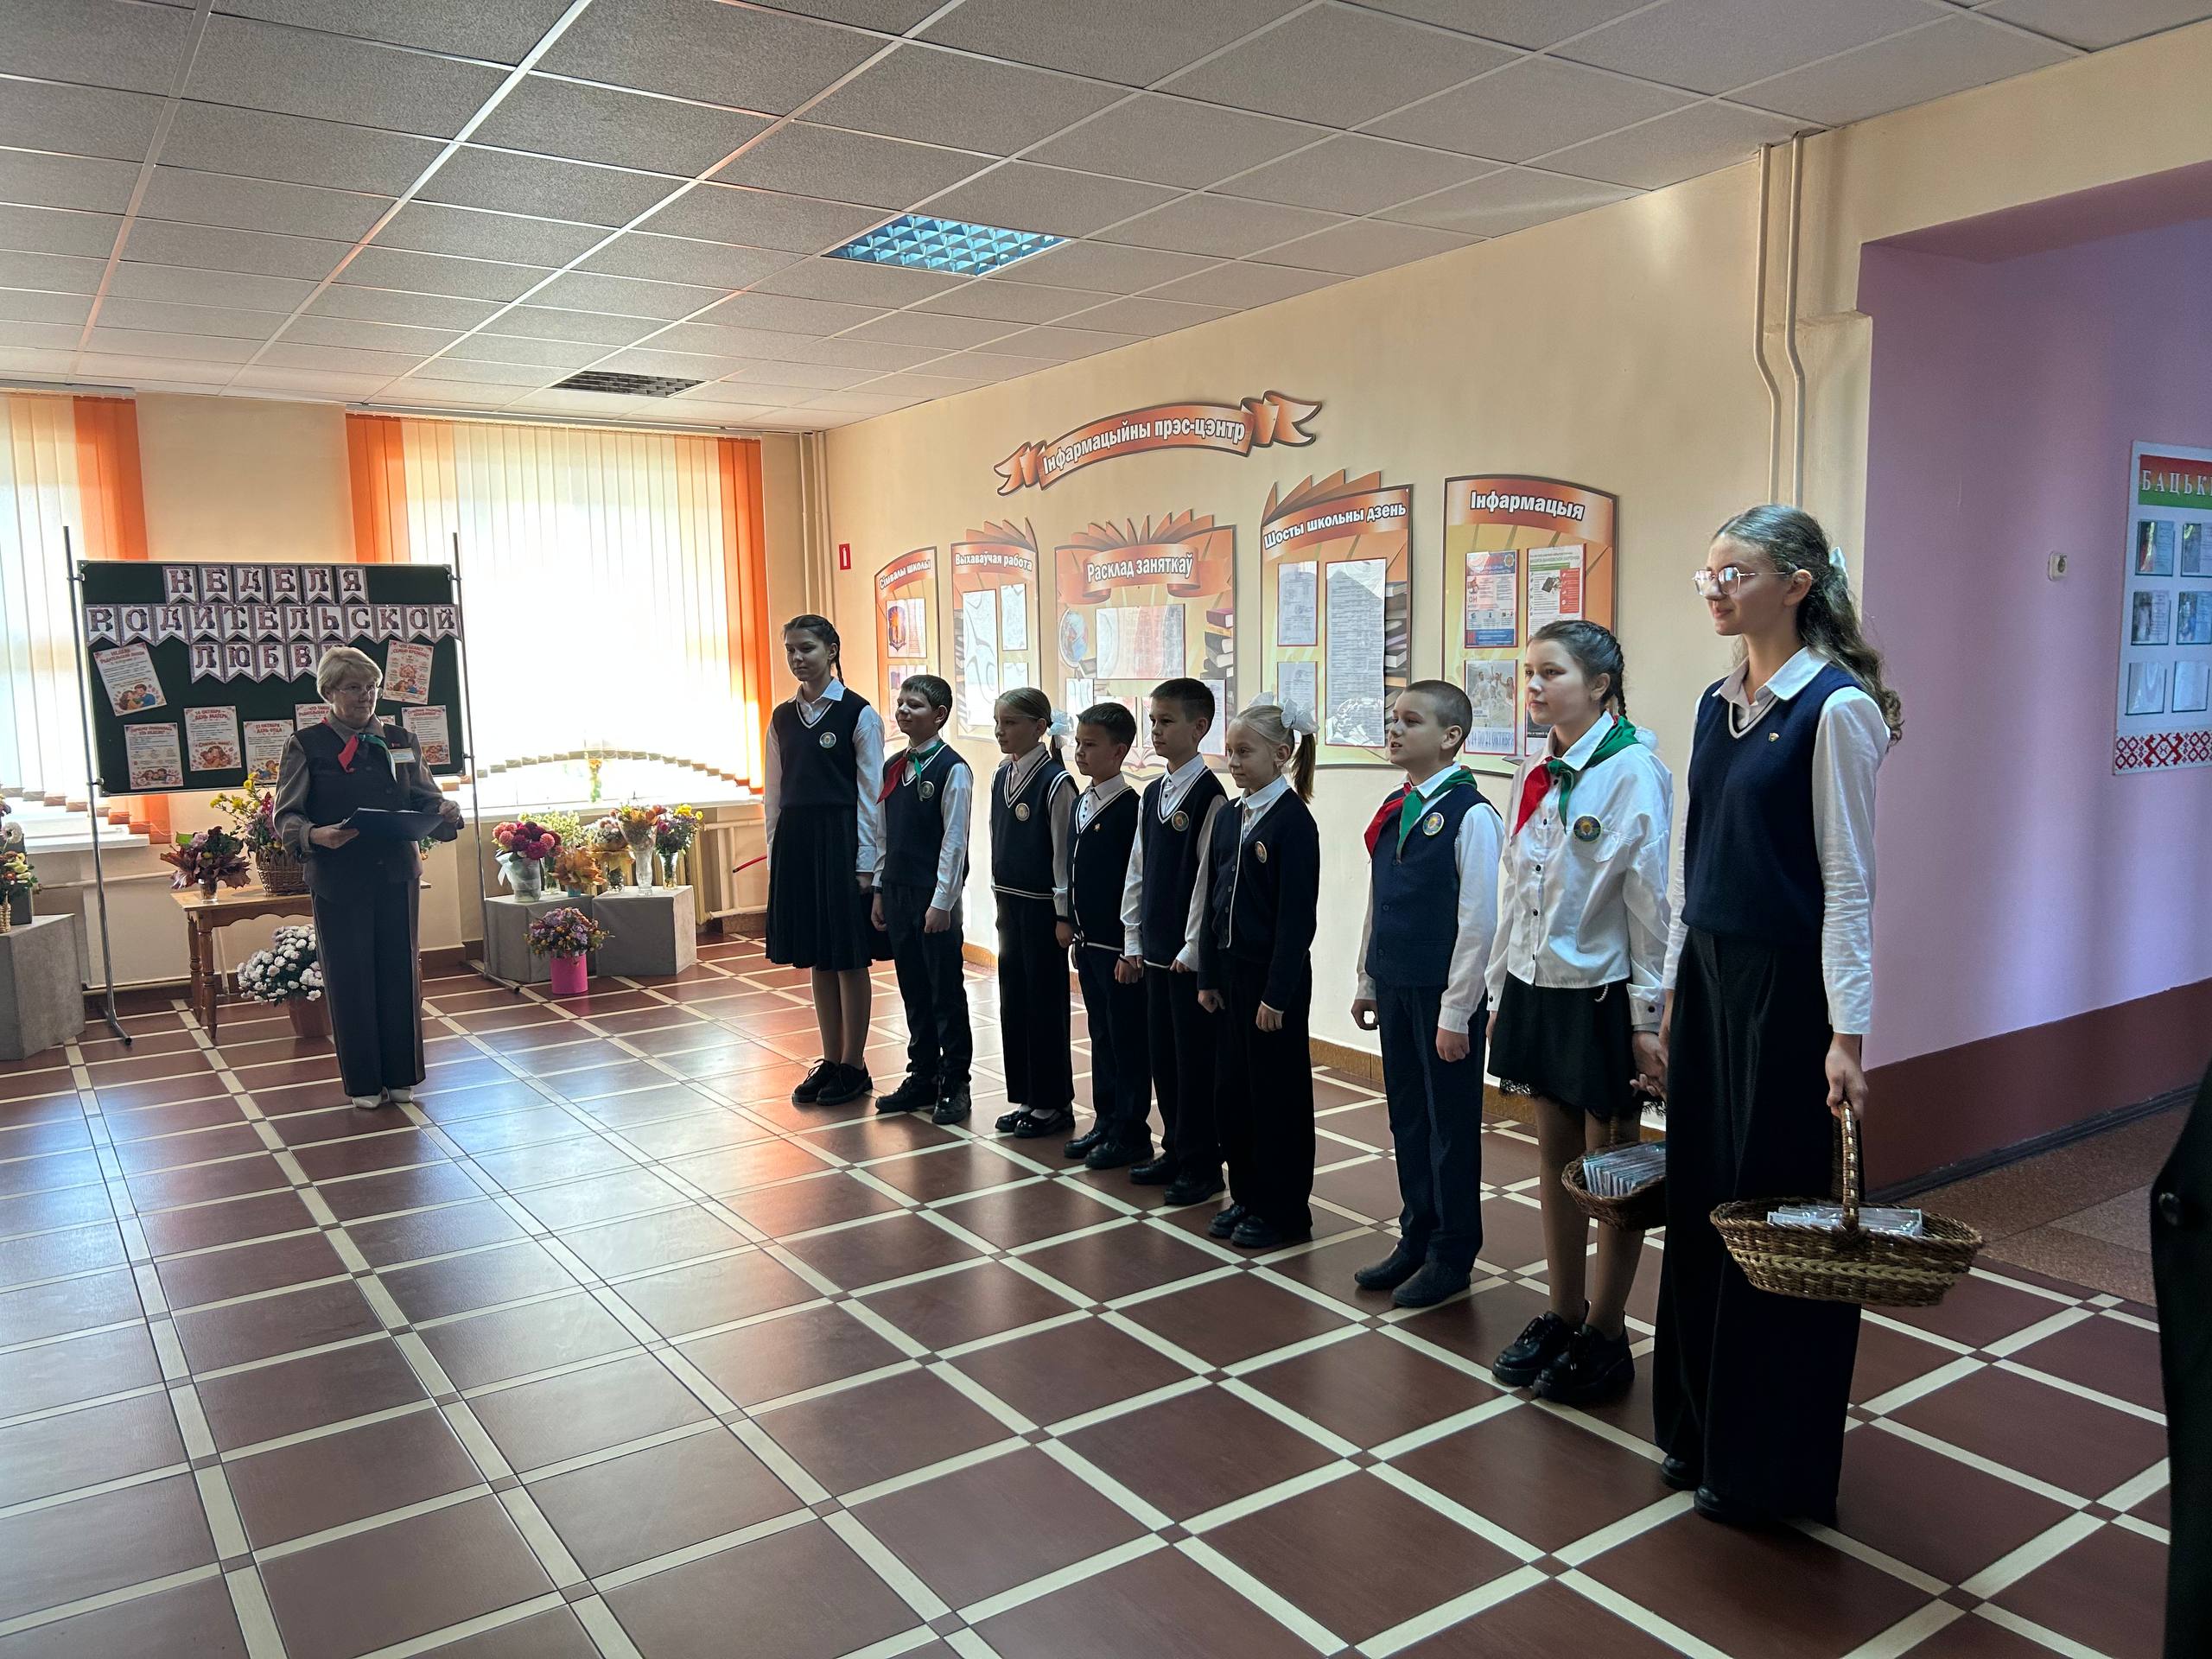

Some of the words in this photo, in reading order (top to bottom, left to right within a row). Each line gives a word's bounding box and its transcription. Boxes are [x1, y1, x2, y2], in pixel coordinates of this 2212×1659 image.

[1041, 418, 1152, 476] Інфармацыйны
[1154, 414, 1246, 444] прэс-цэнтр
[2141, 469, 2212, 496] БАЦЬК
[1470, 490, 1586, 522] Інфармацыя
[1263, 521, 1305, 550] Шосты
[1306, 507, 1365, 533] школьны
[1366, 502, 1408, 523] дзень
[879, 568, 906, 590] Сімвалы
[906, 558, 931, 574] школы
[955, 550, 1002, 566] Выхаваўчая
[1003, 554, 1033, 572] работа
[1086, 560, 1135, 583] Расклад
[1135, 551, 1194, 579] заняткаў
[170, 568, 362, 594] НЕДЕЛЯ
[90, 607, 455, 632] РОДИТЕЛЬСКОЙ
[194, 645, 346, 668] ЛЮБВ
